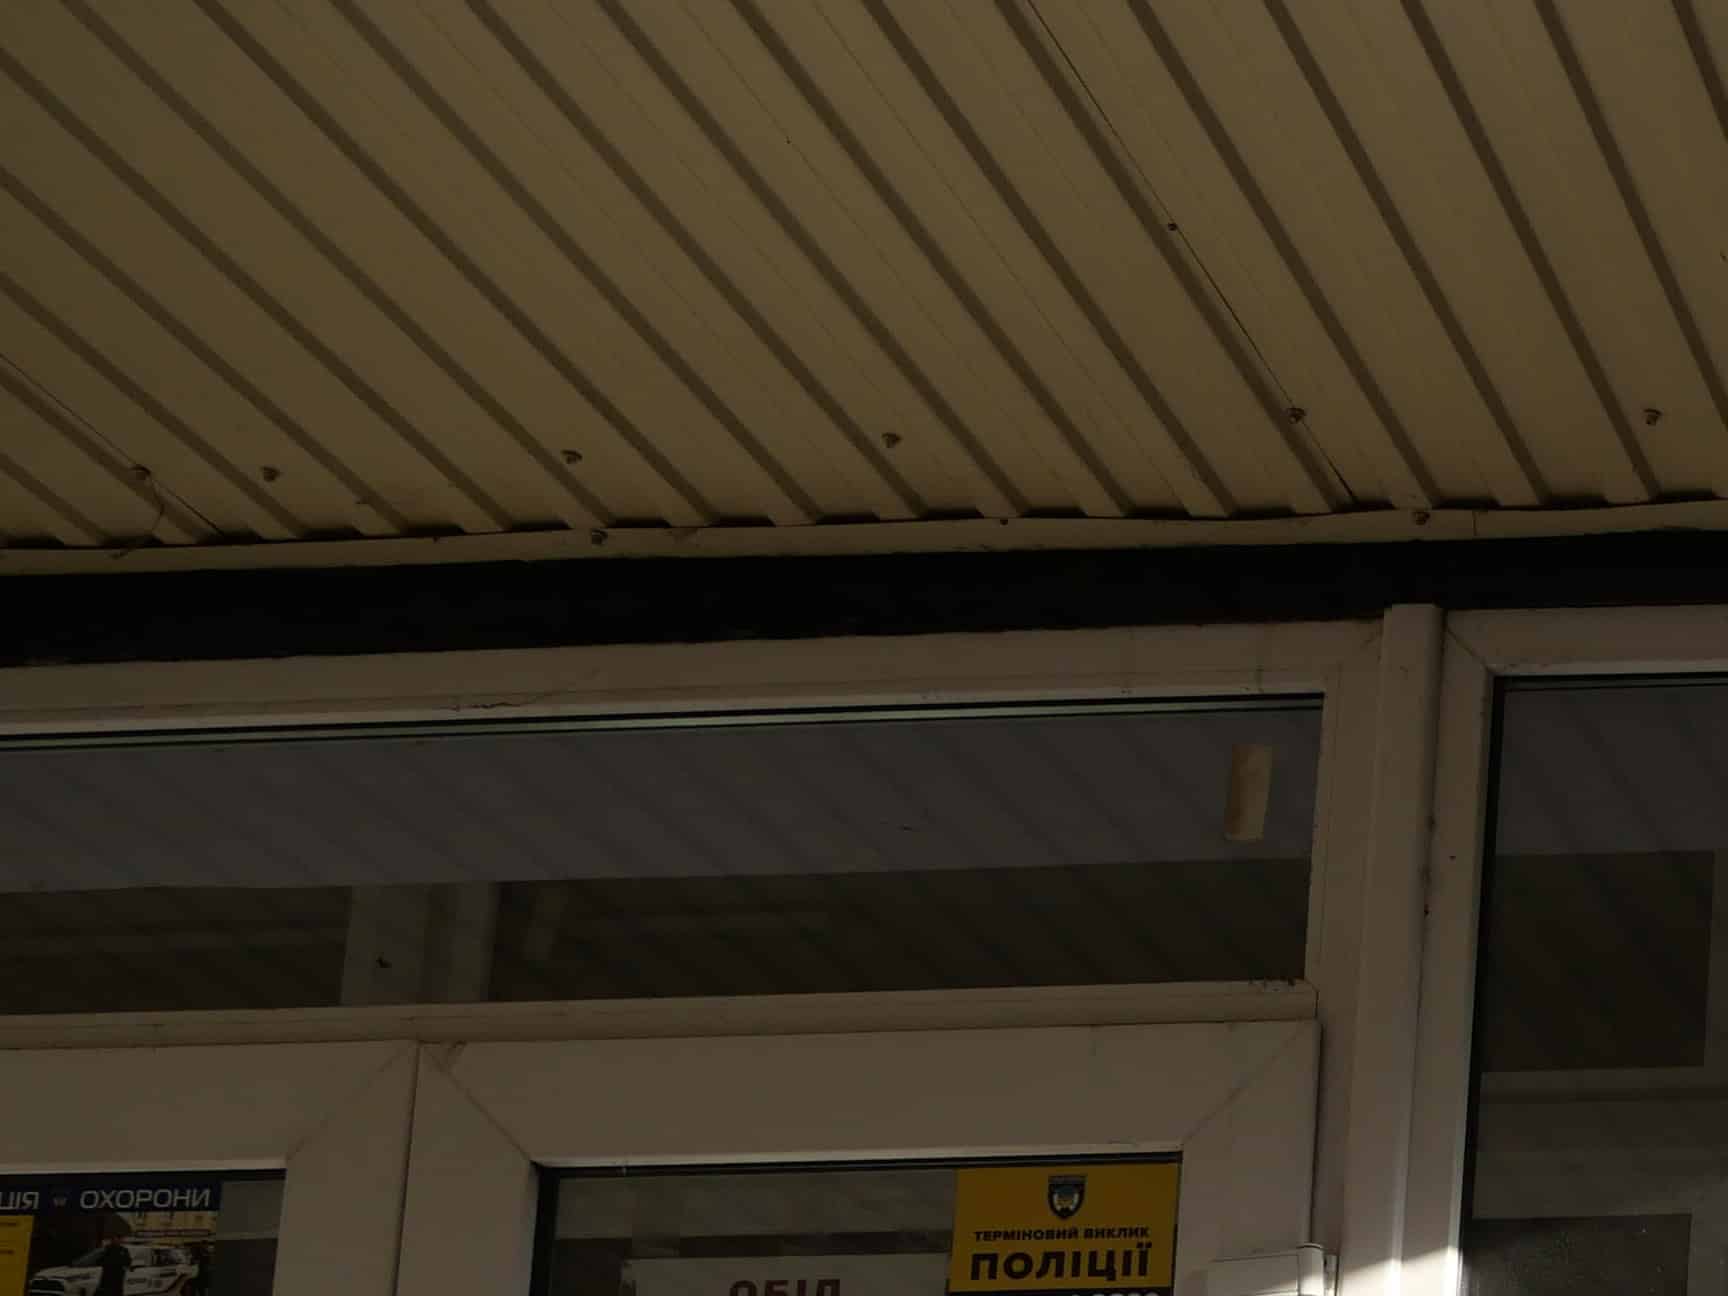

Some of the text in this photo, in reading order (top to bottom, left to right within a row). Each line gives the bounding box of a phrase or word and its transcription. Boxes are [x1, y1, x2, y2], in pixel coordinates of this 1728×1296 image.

[80, 1188, 211, 1209] ОХОРОНИ
[974, 1226, 1150, 1242] ТЕРМІНОВИЙ ВИКЛИК
[970, 1242, 1153, 1282] ПОЛІЦІЇ
